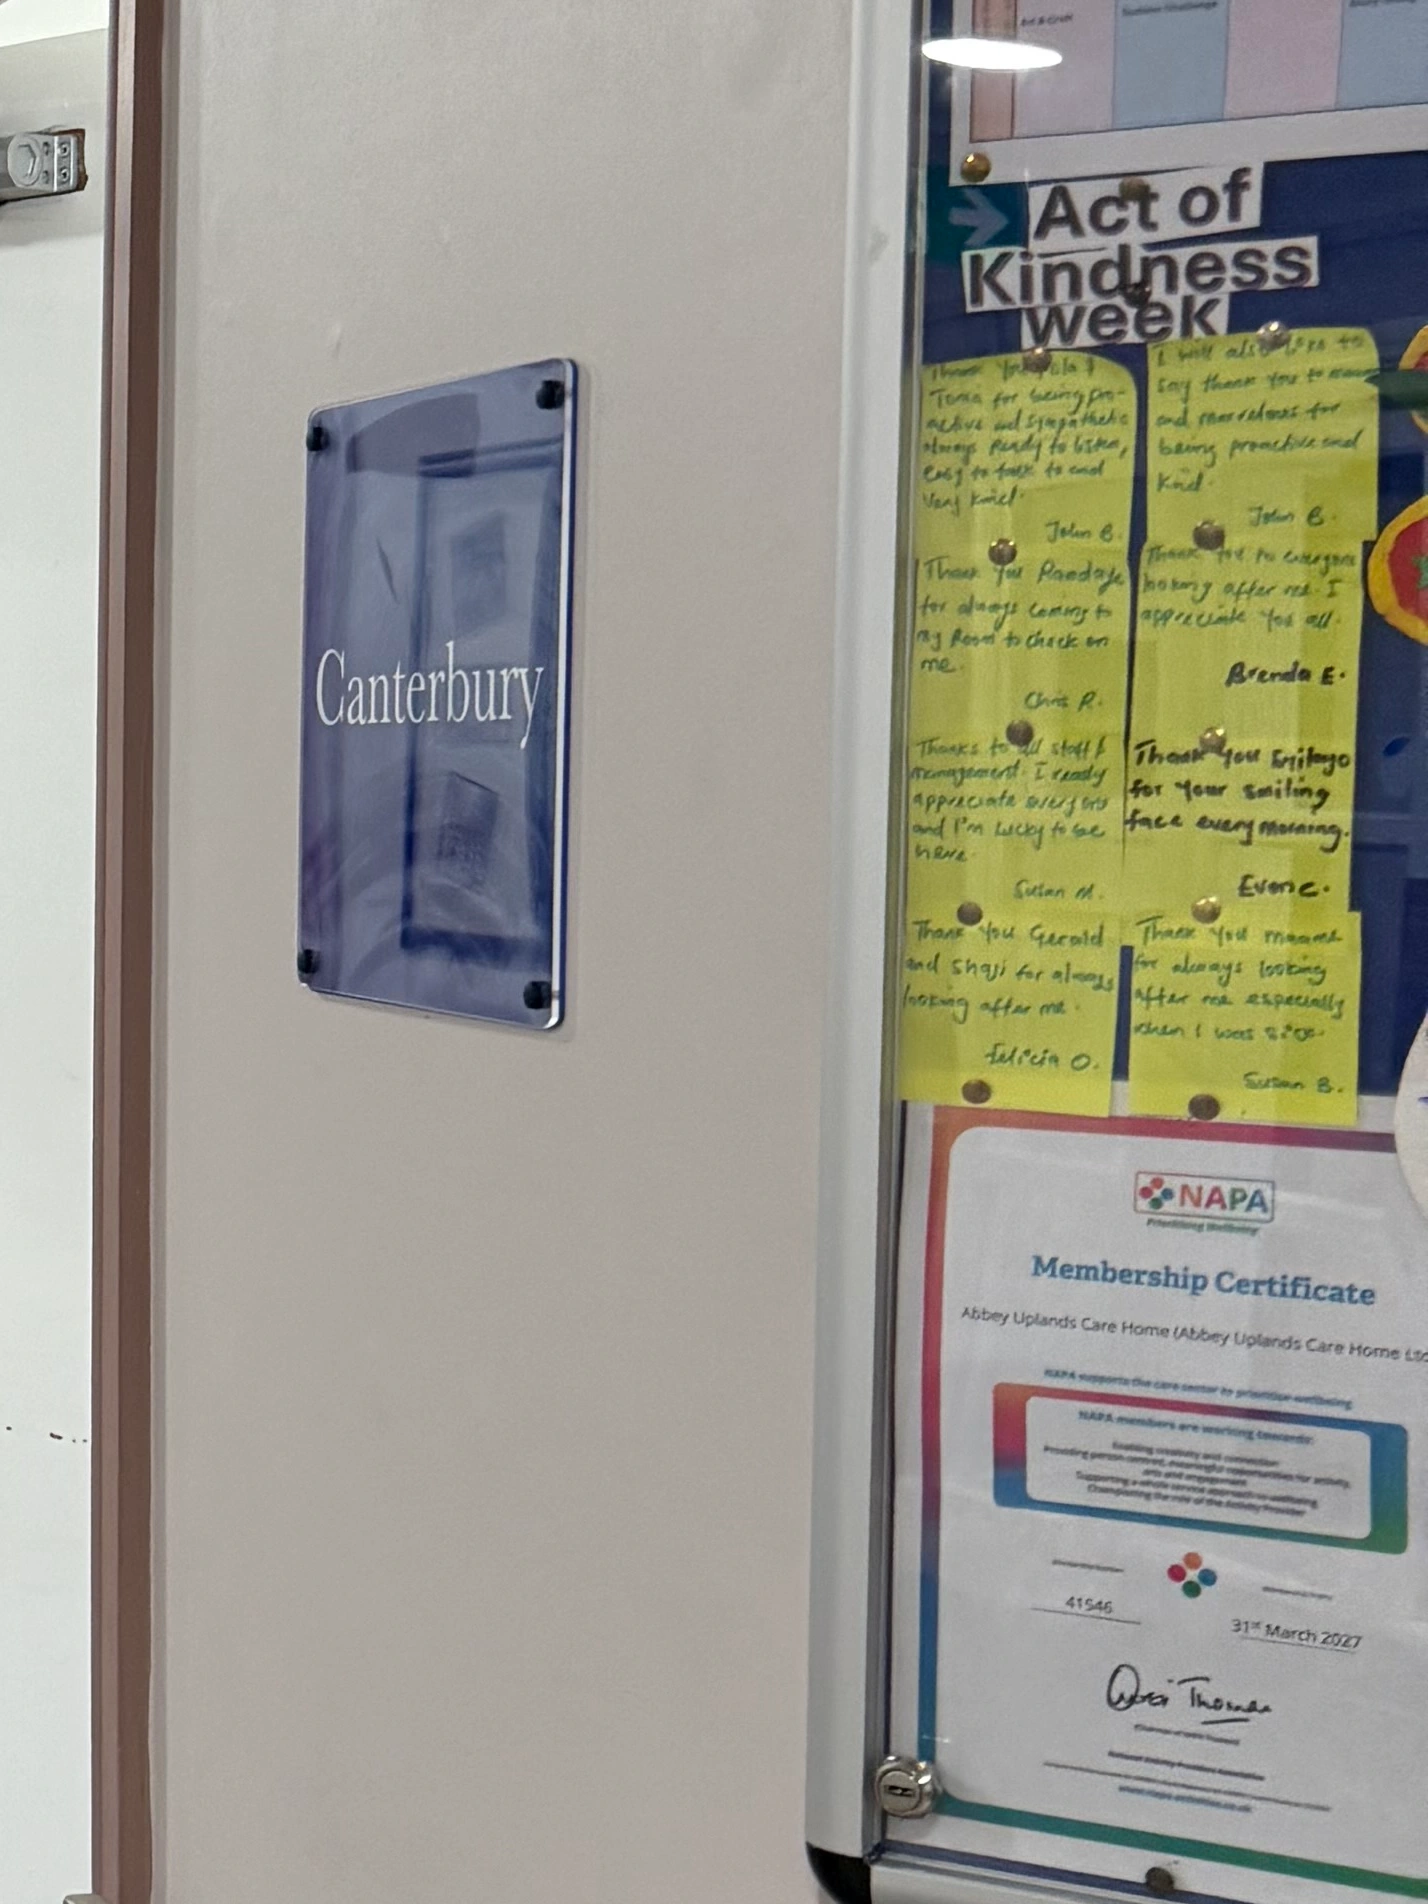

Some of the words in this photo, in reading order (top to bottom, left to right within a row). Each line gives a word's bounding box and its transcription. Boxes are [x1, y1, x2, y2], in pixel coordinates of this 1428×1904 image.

[1032, 184, 1160, 241] Act
[1178, 167, 1253, 227] of
[968, 242, 1314, 308] Kindness
[315, 641, 545, 750] Canterbury
[1224, 660, 1312, 688] Brenda
[1129, 778, 1162, 798] for
[1125, 808, 1183, 833] face
[1196, 815, 1254, 846] every
[1178, 1182, 1270, 1214] NAPA
[1031, 1254, 1209, 1296] Membership
[1215, 1271, 1377, 1306] Certificate
[961, 1306, 1011, 1326] Abbey
[1013, 1311, 1077, 1333] Uplands
[1080, 1317, 1118, 1334] Care
[1121, 1322, 1171, 1339] Home
[1173, 1324, 1230, 1347] (Abbey
[1234, 1331, 1302, 1352] Uplands
[1305, 1337, 1345, 1356] Care
[1349, 1343, 1401, 1362] Home
[1264, 1623, 1317, 1644] March
